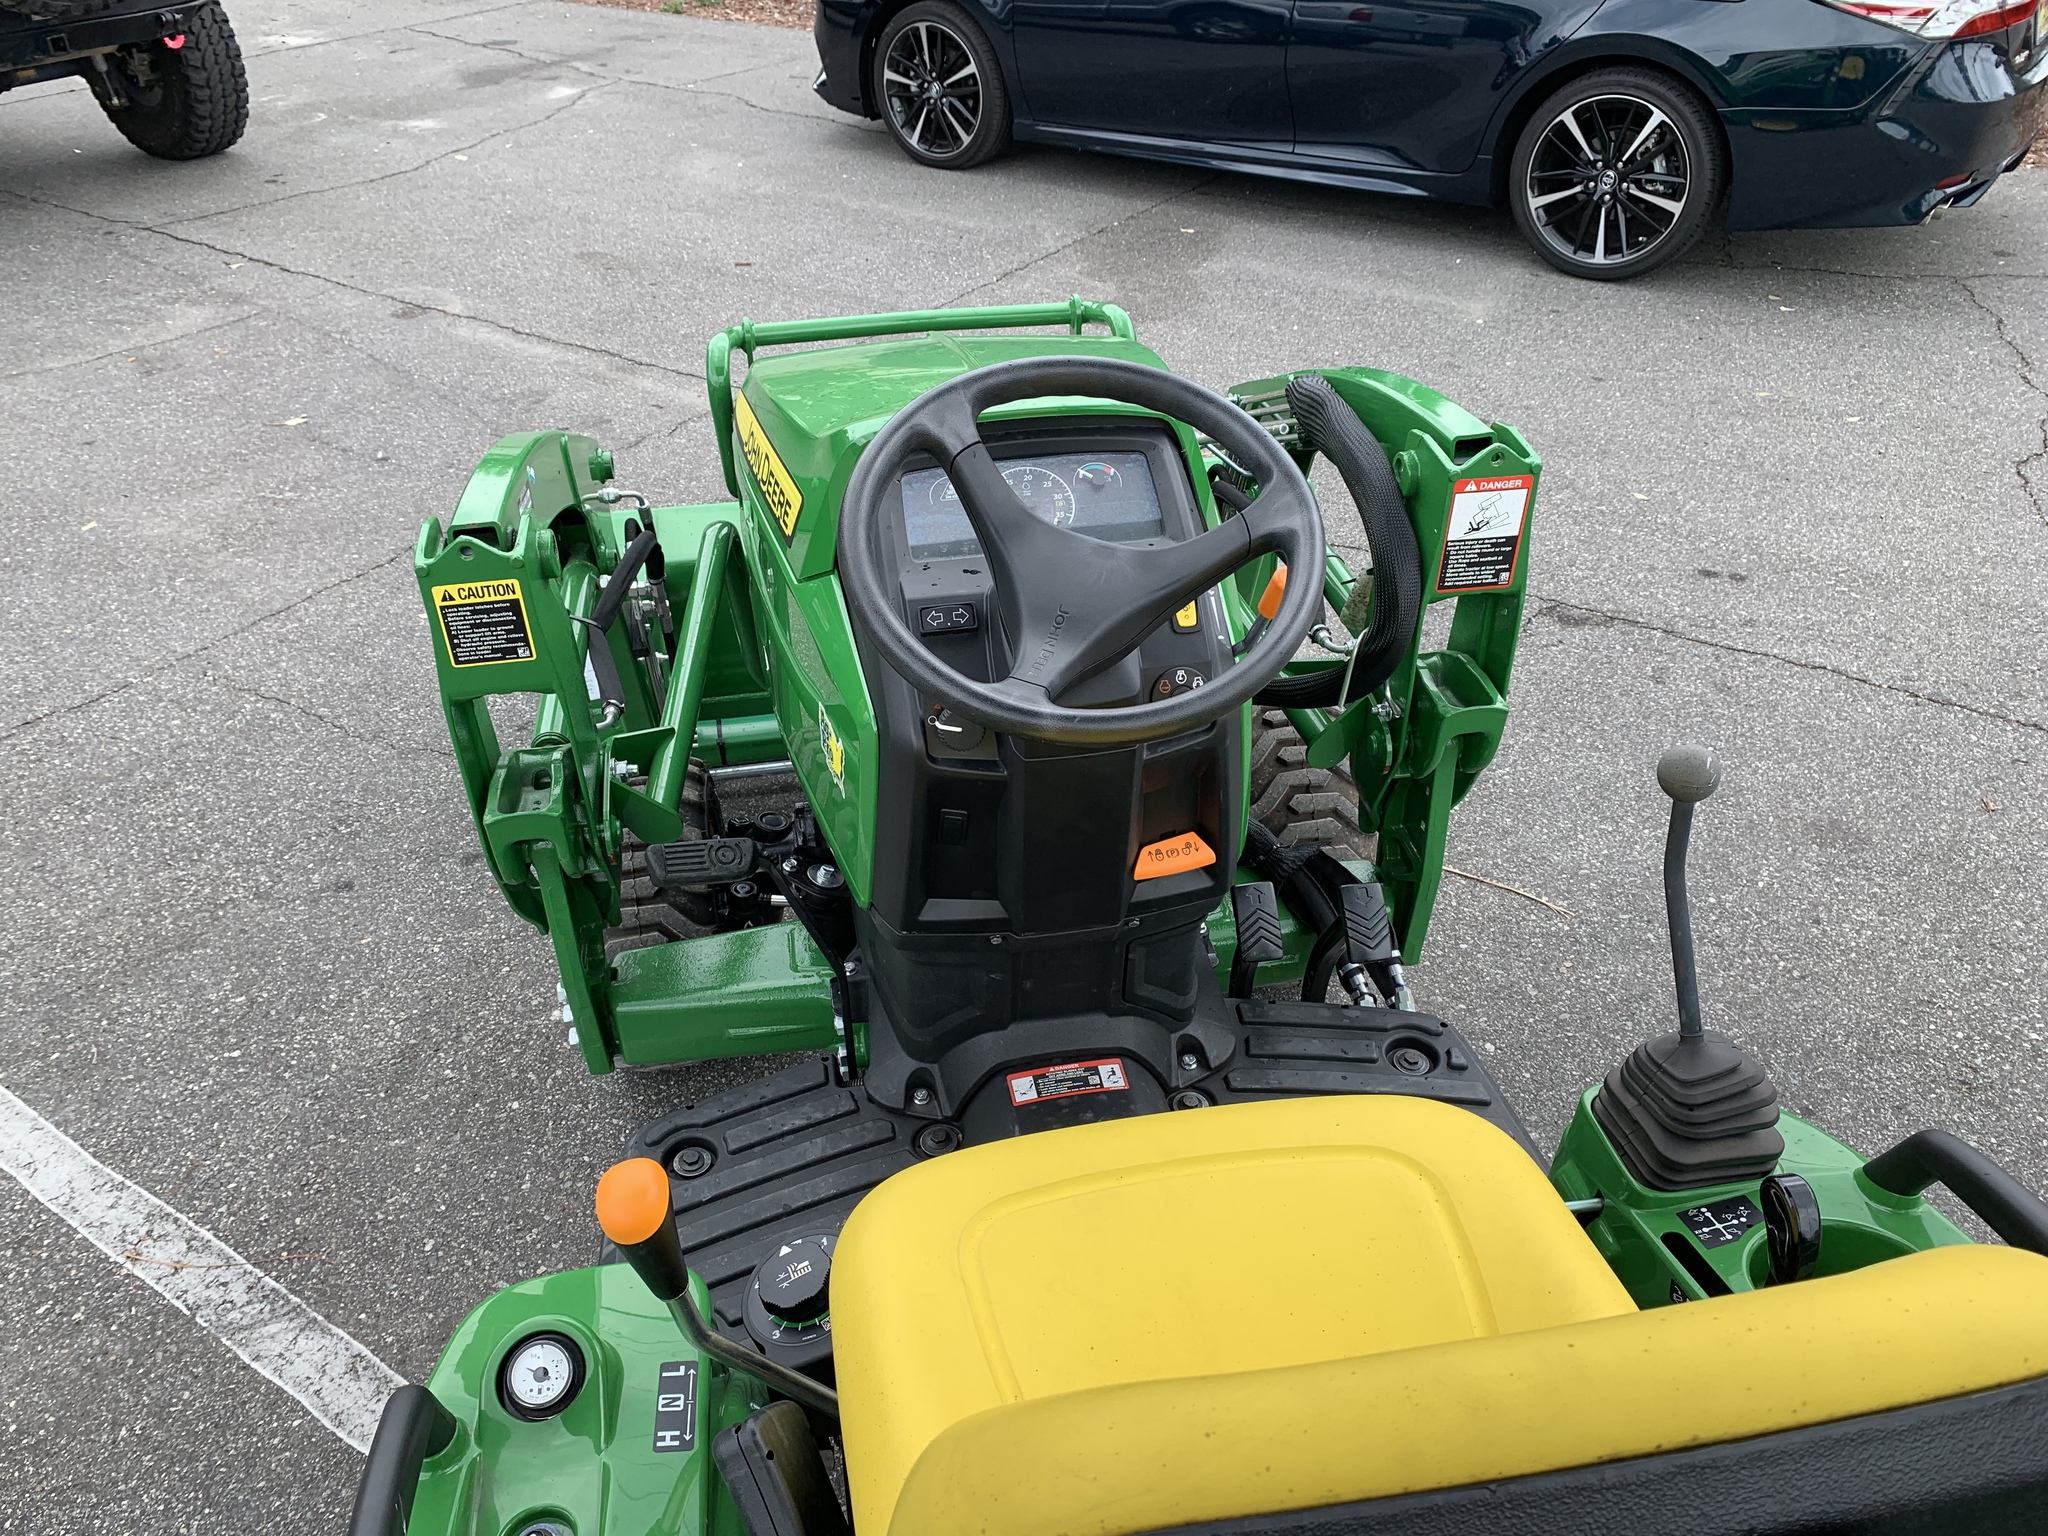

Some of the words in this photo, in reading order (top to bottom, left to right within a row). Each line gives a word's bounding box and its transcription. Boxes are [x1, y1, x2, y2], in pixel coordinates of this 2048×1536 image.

[744, 421, 764, 480] JOHN
[759, 452, 792, 530] DEERE
[1480, 480, 1522, 490] DANGER
[458, 583, 516, 600] CAUTION
[1045, 604, 1070, 648] JOHN
[821, 1237, 827, 1246] 1
[772, 1330, 780, 1339] 3
[662, 1365, 685, 1376] L
[660, 1396, 683, 1410] N
[656, 1430, 680, 1446] H
